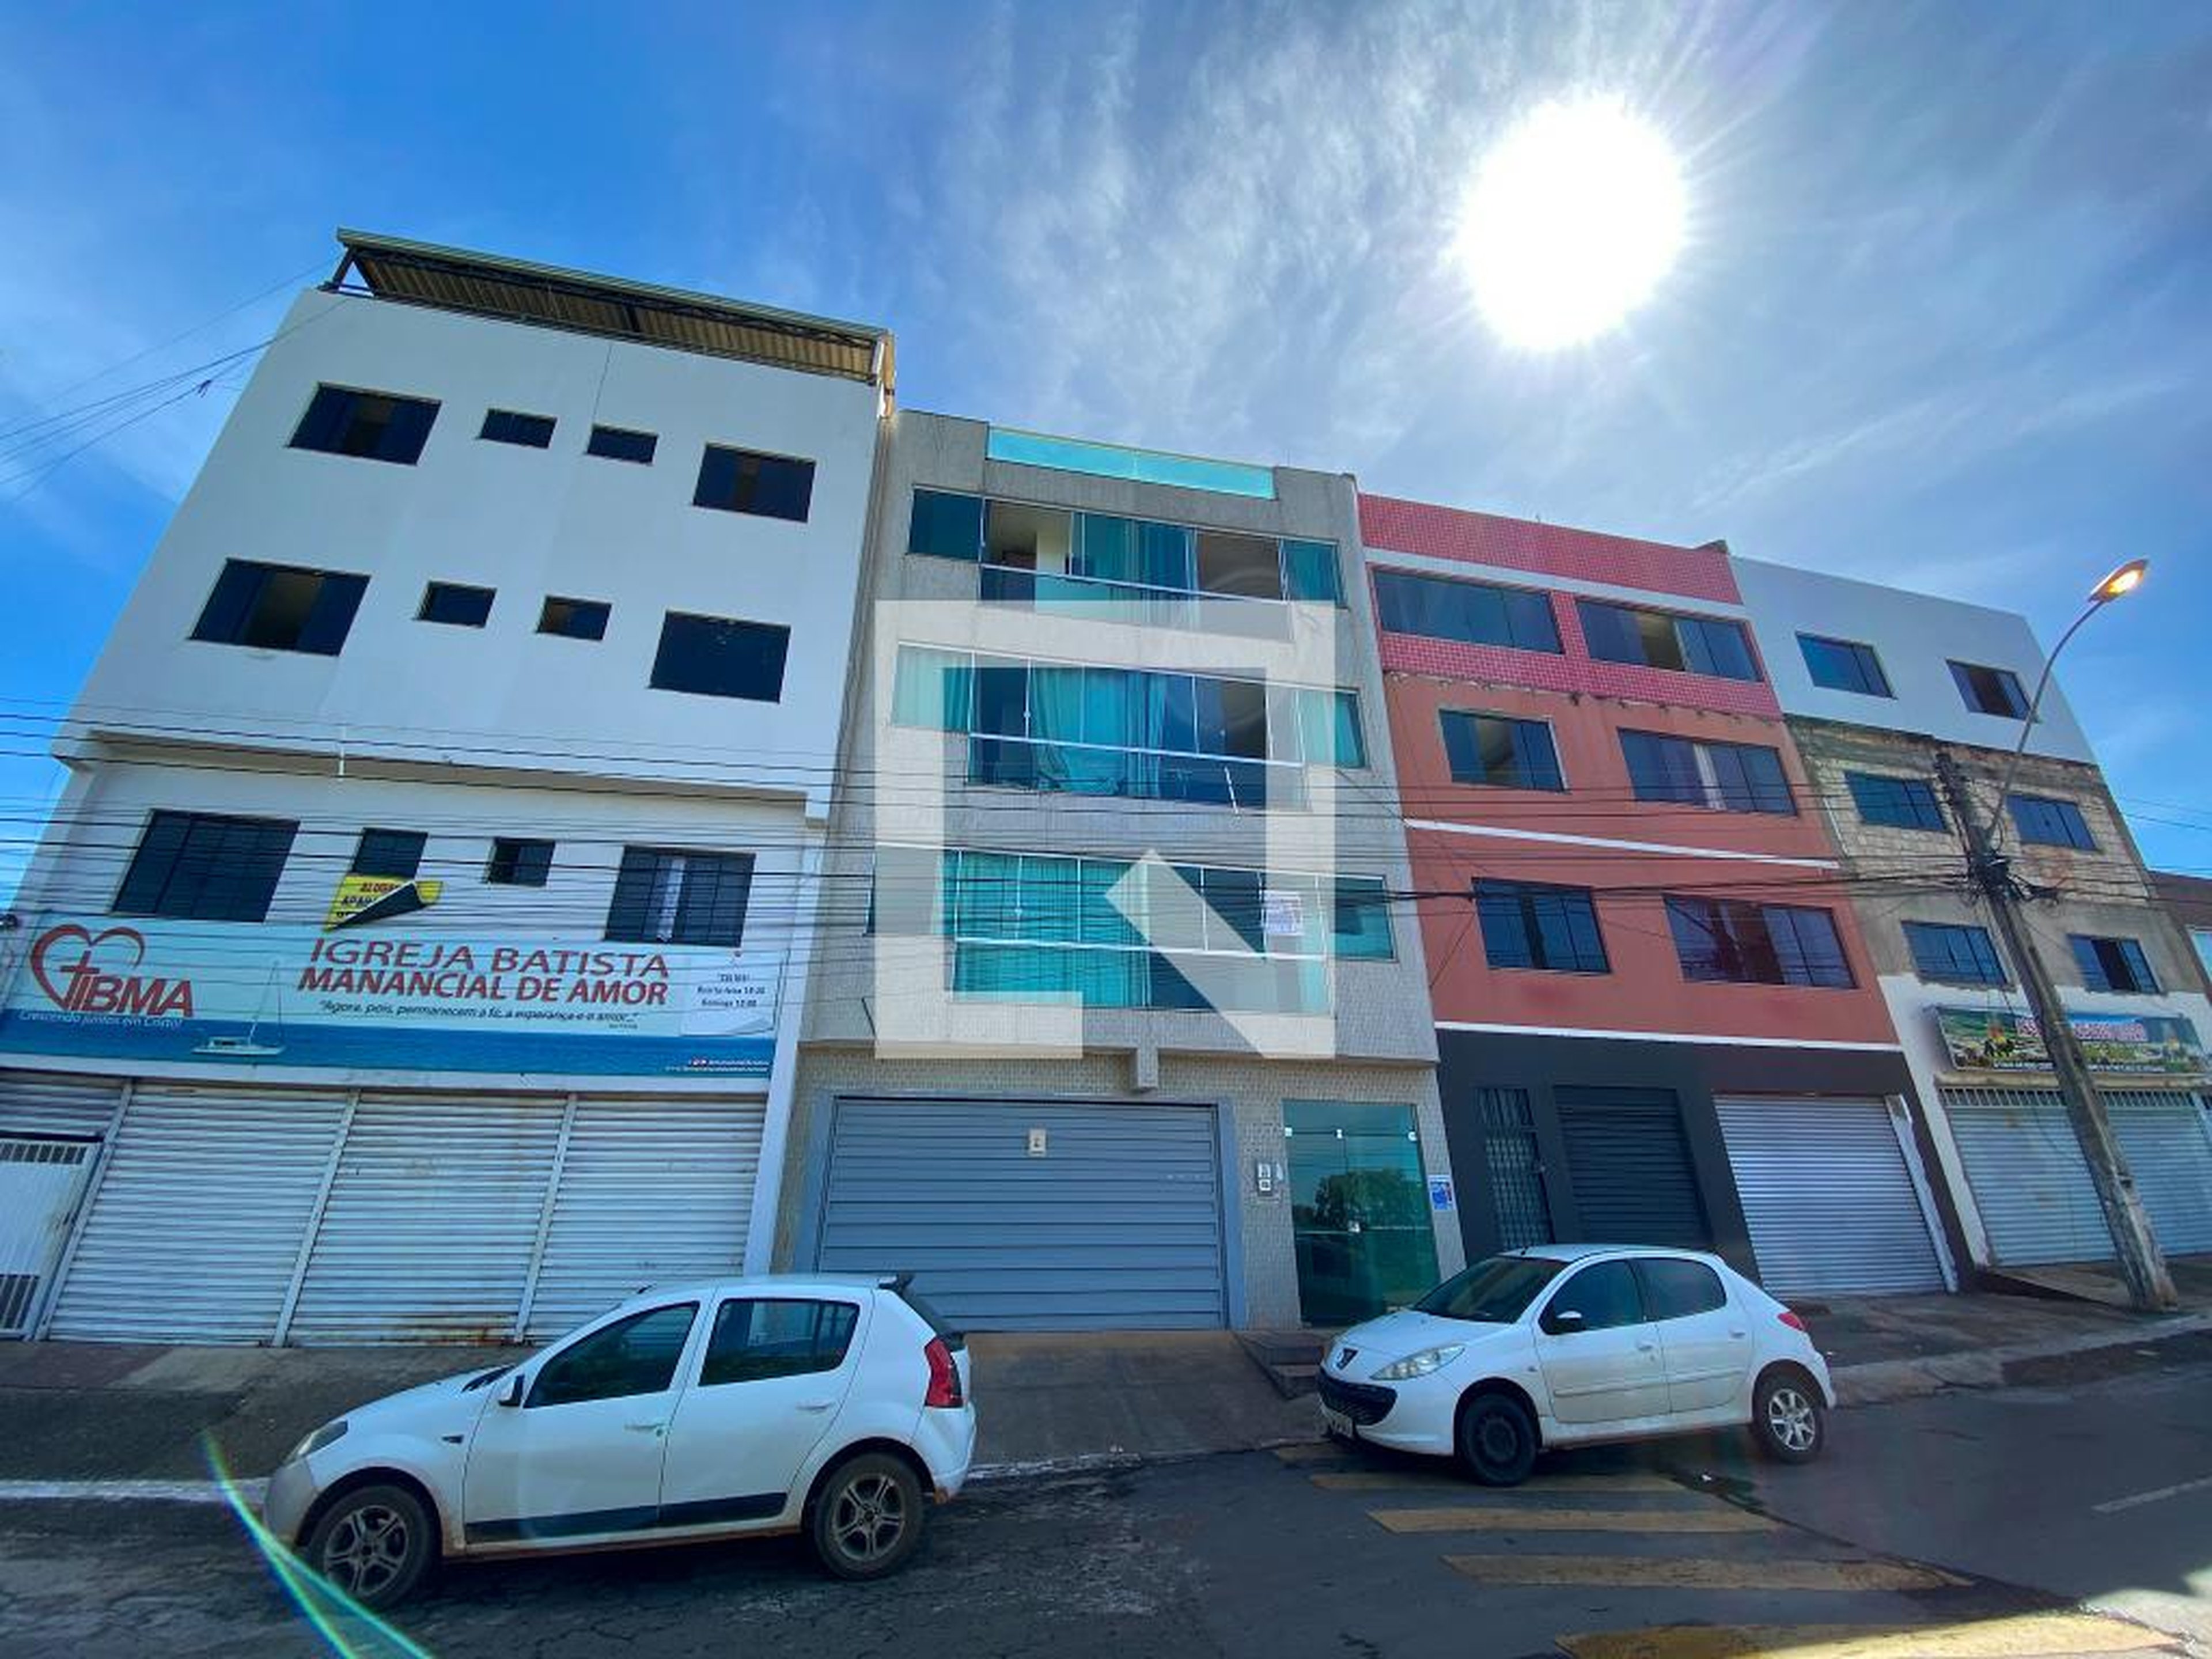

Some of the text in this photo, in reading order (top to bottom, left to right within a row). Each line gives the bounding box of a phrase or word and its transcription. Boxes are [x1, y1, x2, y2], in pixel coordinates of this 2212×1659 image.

[310, 938, 669, 978] IGREJA BATISTA
[298, 967, 669, 1005] MANANCIAL DE AMOR
